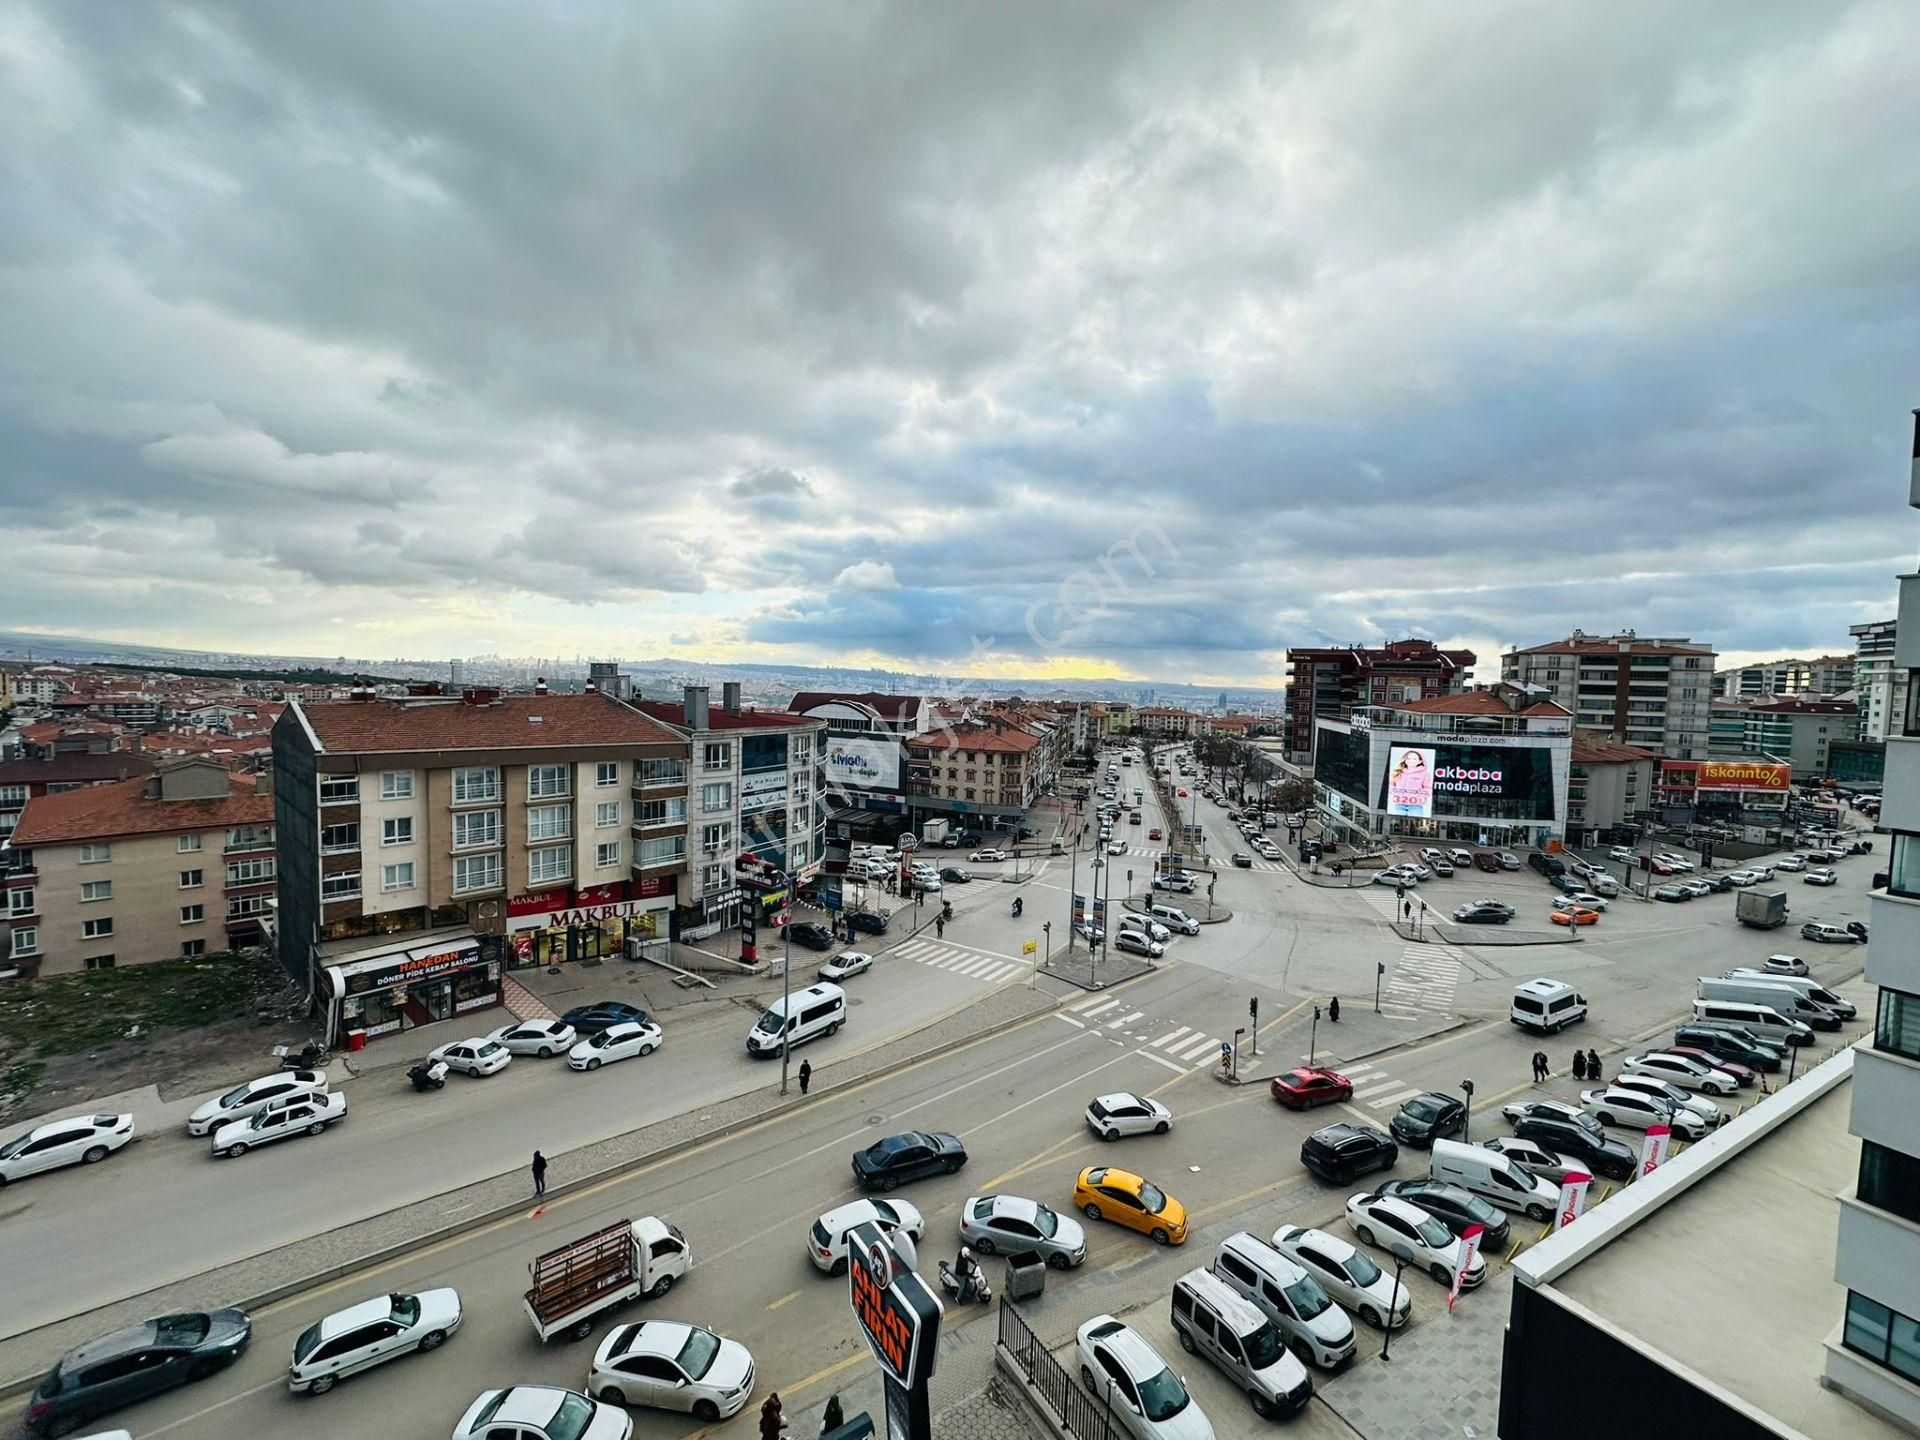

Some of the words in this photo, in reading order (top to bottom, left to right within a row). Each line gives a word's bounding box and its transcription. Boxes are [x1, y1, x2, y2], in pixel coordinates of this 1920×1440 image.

[1434, 766, 1503, 782] akbaba
[1433, 782, 1503, 795] modaplaza
[717, 890, 742, 902] emla
[549, 902, 640, 928] MAKBUL
[377, 973, 405, 986] DÖNER
[406, 968, 424, 979] PİDE
[425, 961, 450, 975] KEBAP
[450, 955, 480, 967] SALONU
[399, 951, 460, 973] HANEDAN
[851, 1257, 911, 1350] AHLAT
[853, 1284, 904, 1374] FIRIN
